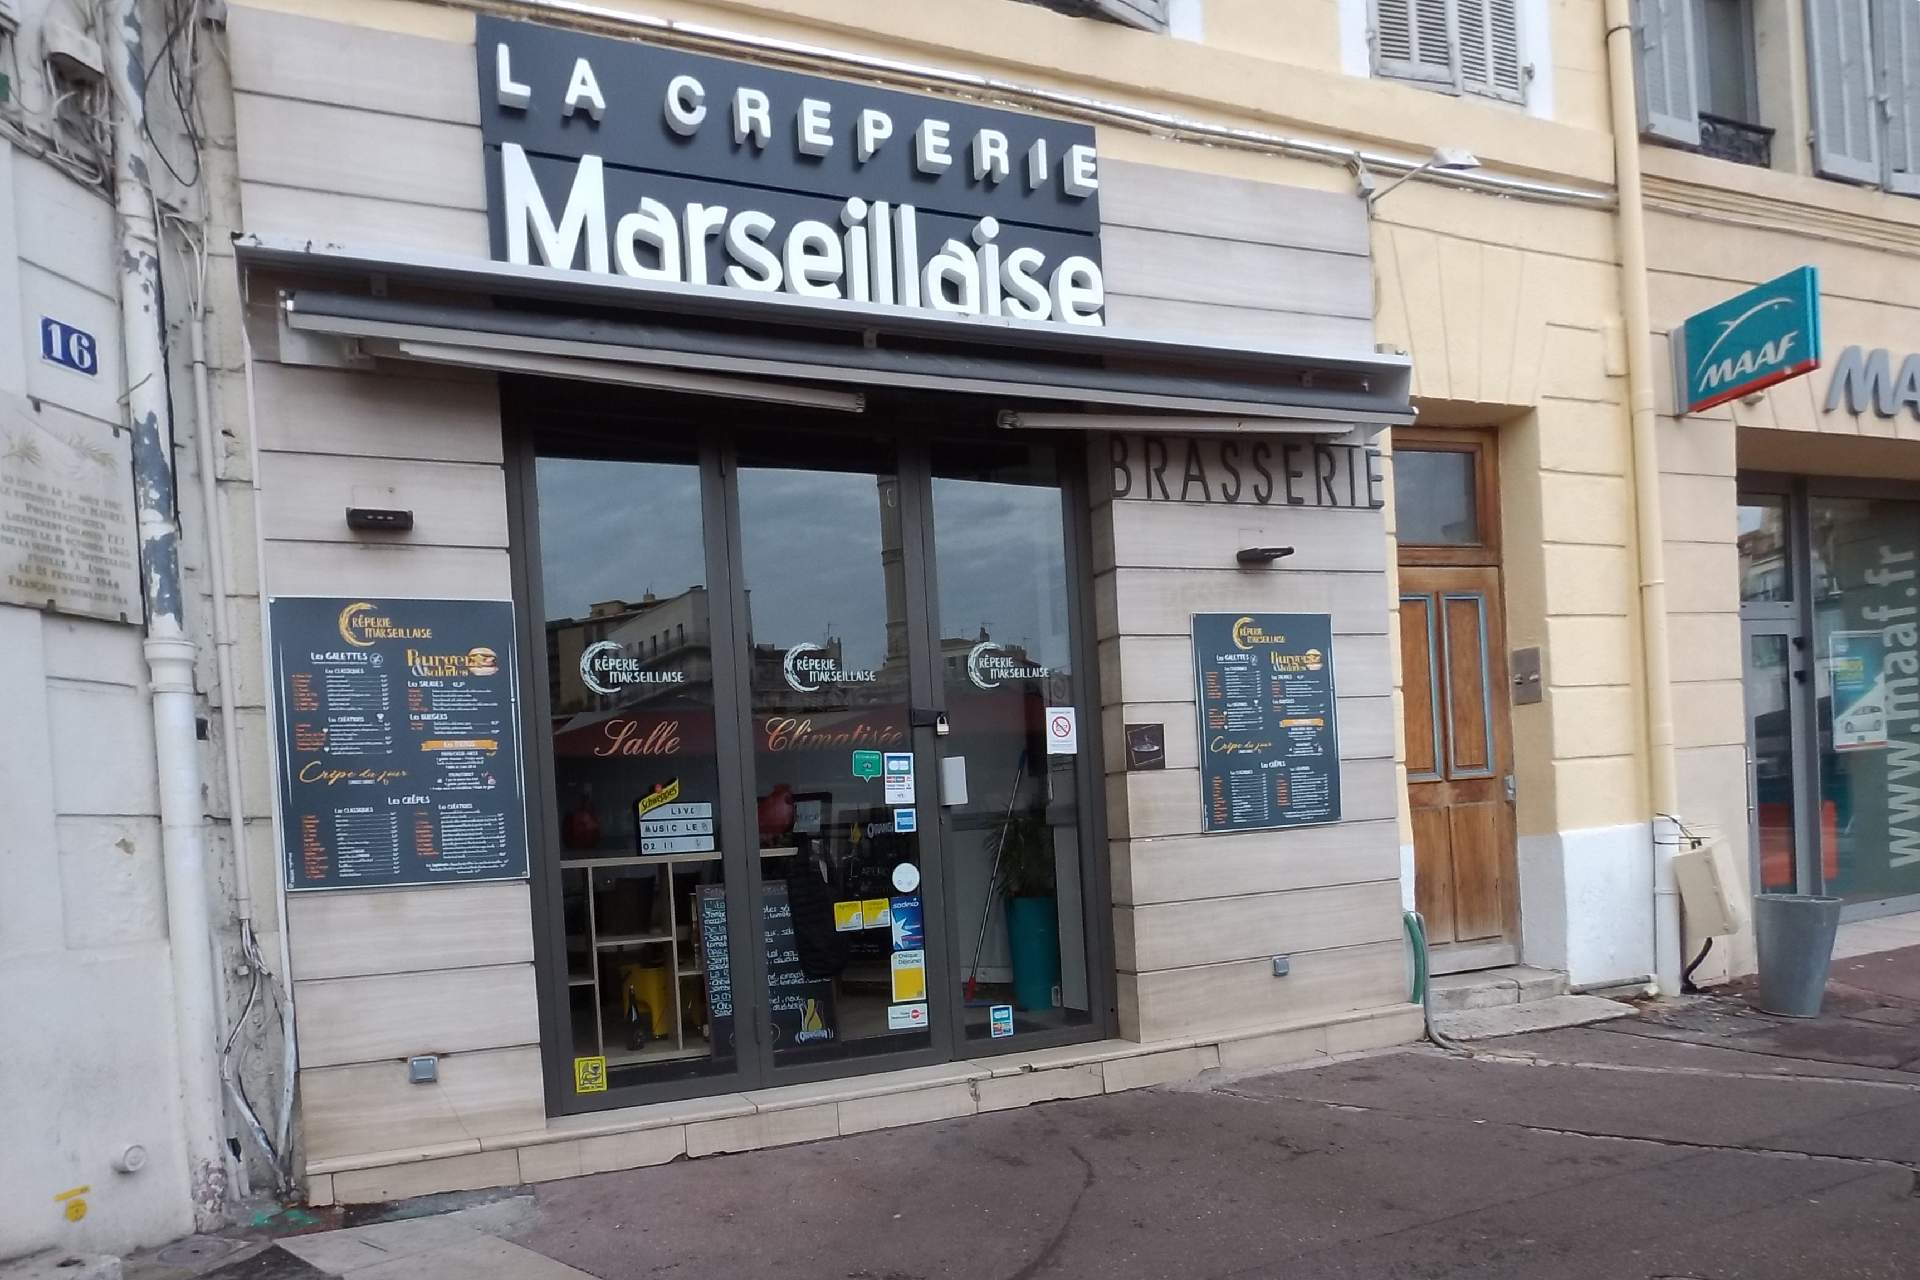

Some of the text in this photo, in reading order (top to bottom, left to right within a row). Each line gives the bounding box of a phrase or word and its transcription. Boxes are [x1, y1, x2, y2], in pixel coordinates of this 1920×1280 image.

[496, 44, 1098, 198] LA CREPERIE
[501, 142, 1105, 326] Marseillaise
[47, 323, 92, 369] 16
[1698, 331, 1798, 393] MAAF
[1110, 435, 1385, 507] BRASSERIE
[365, 627, 432, 639] MARSEILLAISE
[609, 671, 685, 683] MARSEILLAISE
[809, 671, 877, 682] MARSEILLAISE
[990, 667, 1050, 679] MARSEILLAISE
[1861, 545, 1920, 868] www.maaf.fr
[594, 719, 680, 757] Salle
[765, 717, 903, 752] Climatisée
